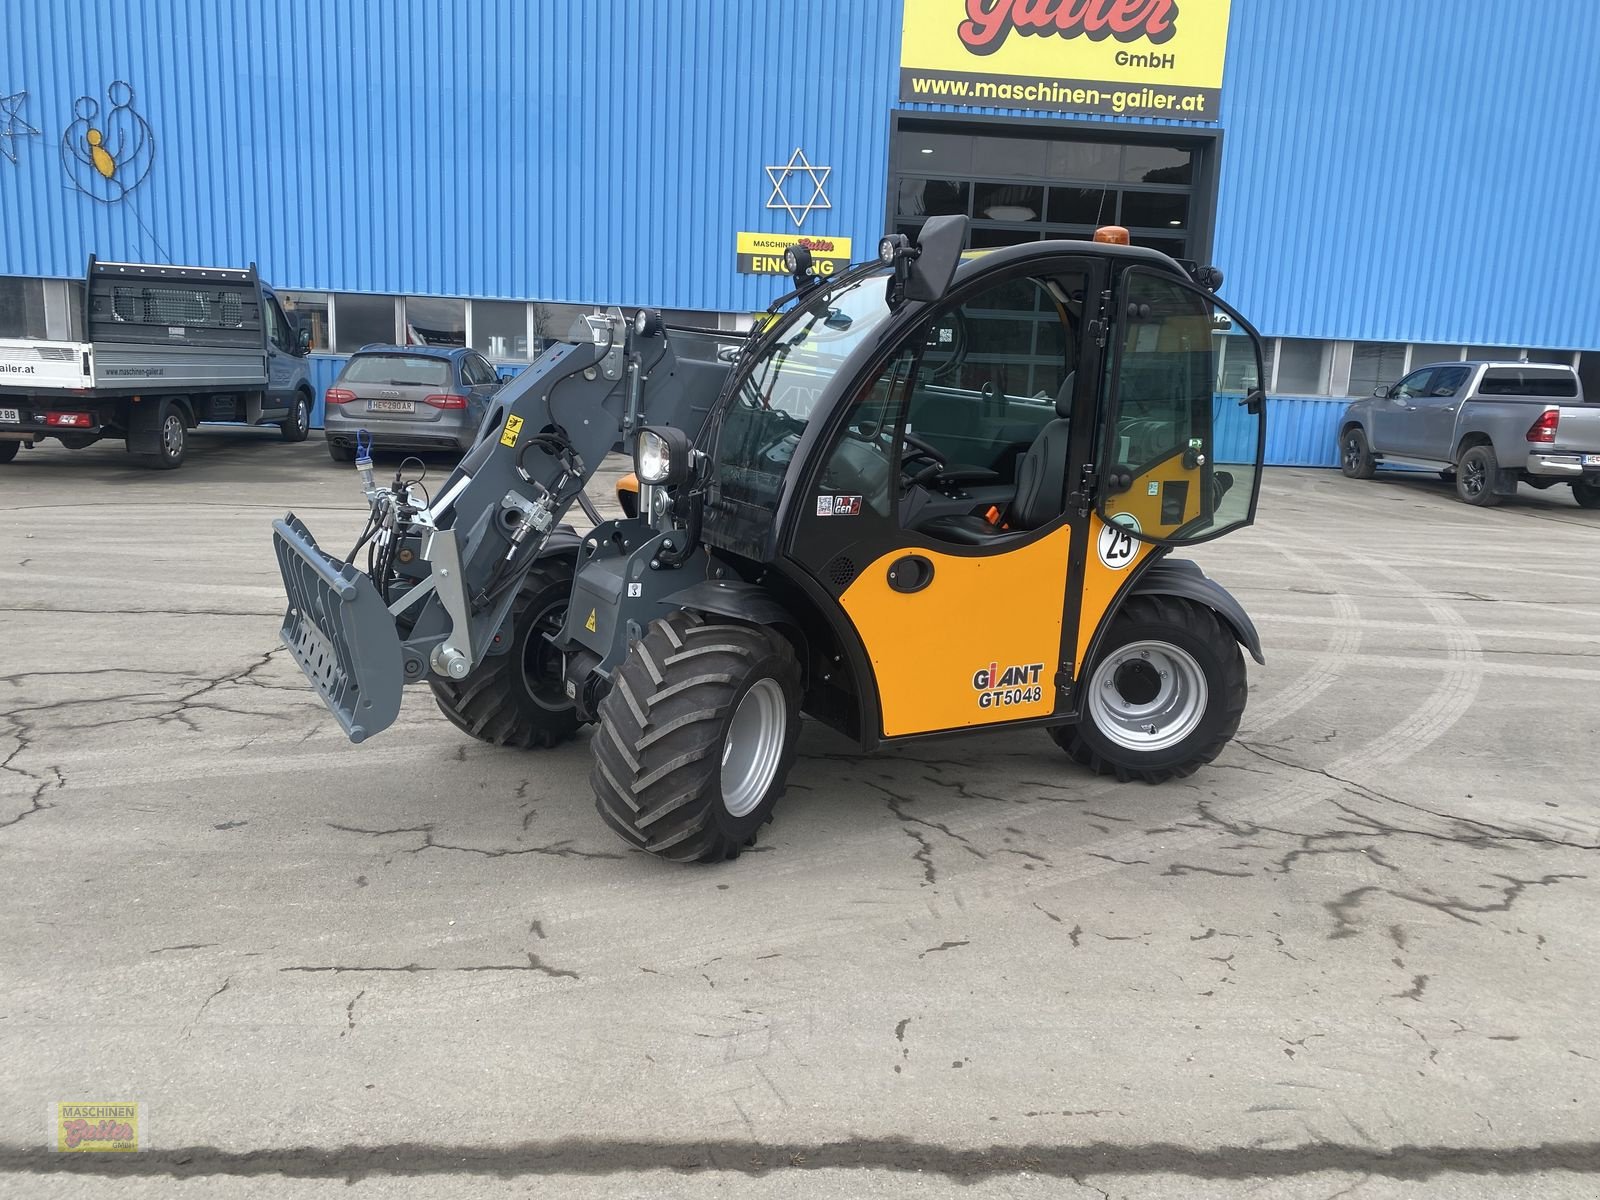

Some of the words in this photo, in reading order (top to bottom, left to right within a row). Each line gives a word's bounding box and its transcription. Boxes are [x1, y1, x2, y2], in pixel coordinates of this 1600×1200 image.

[1114, 51, 1175, 69] GmbH
[912, 77, 1205, 112] www.maschinen-gailer.at
[5, 410, 16, 419] BB
[1106, 523, 1135, 560] 25
[978, 686, 1042, 709] GT5048
